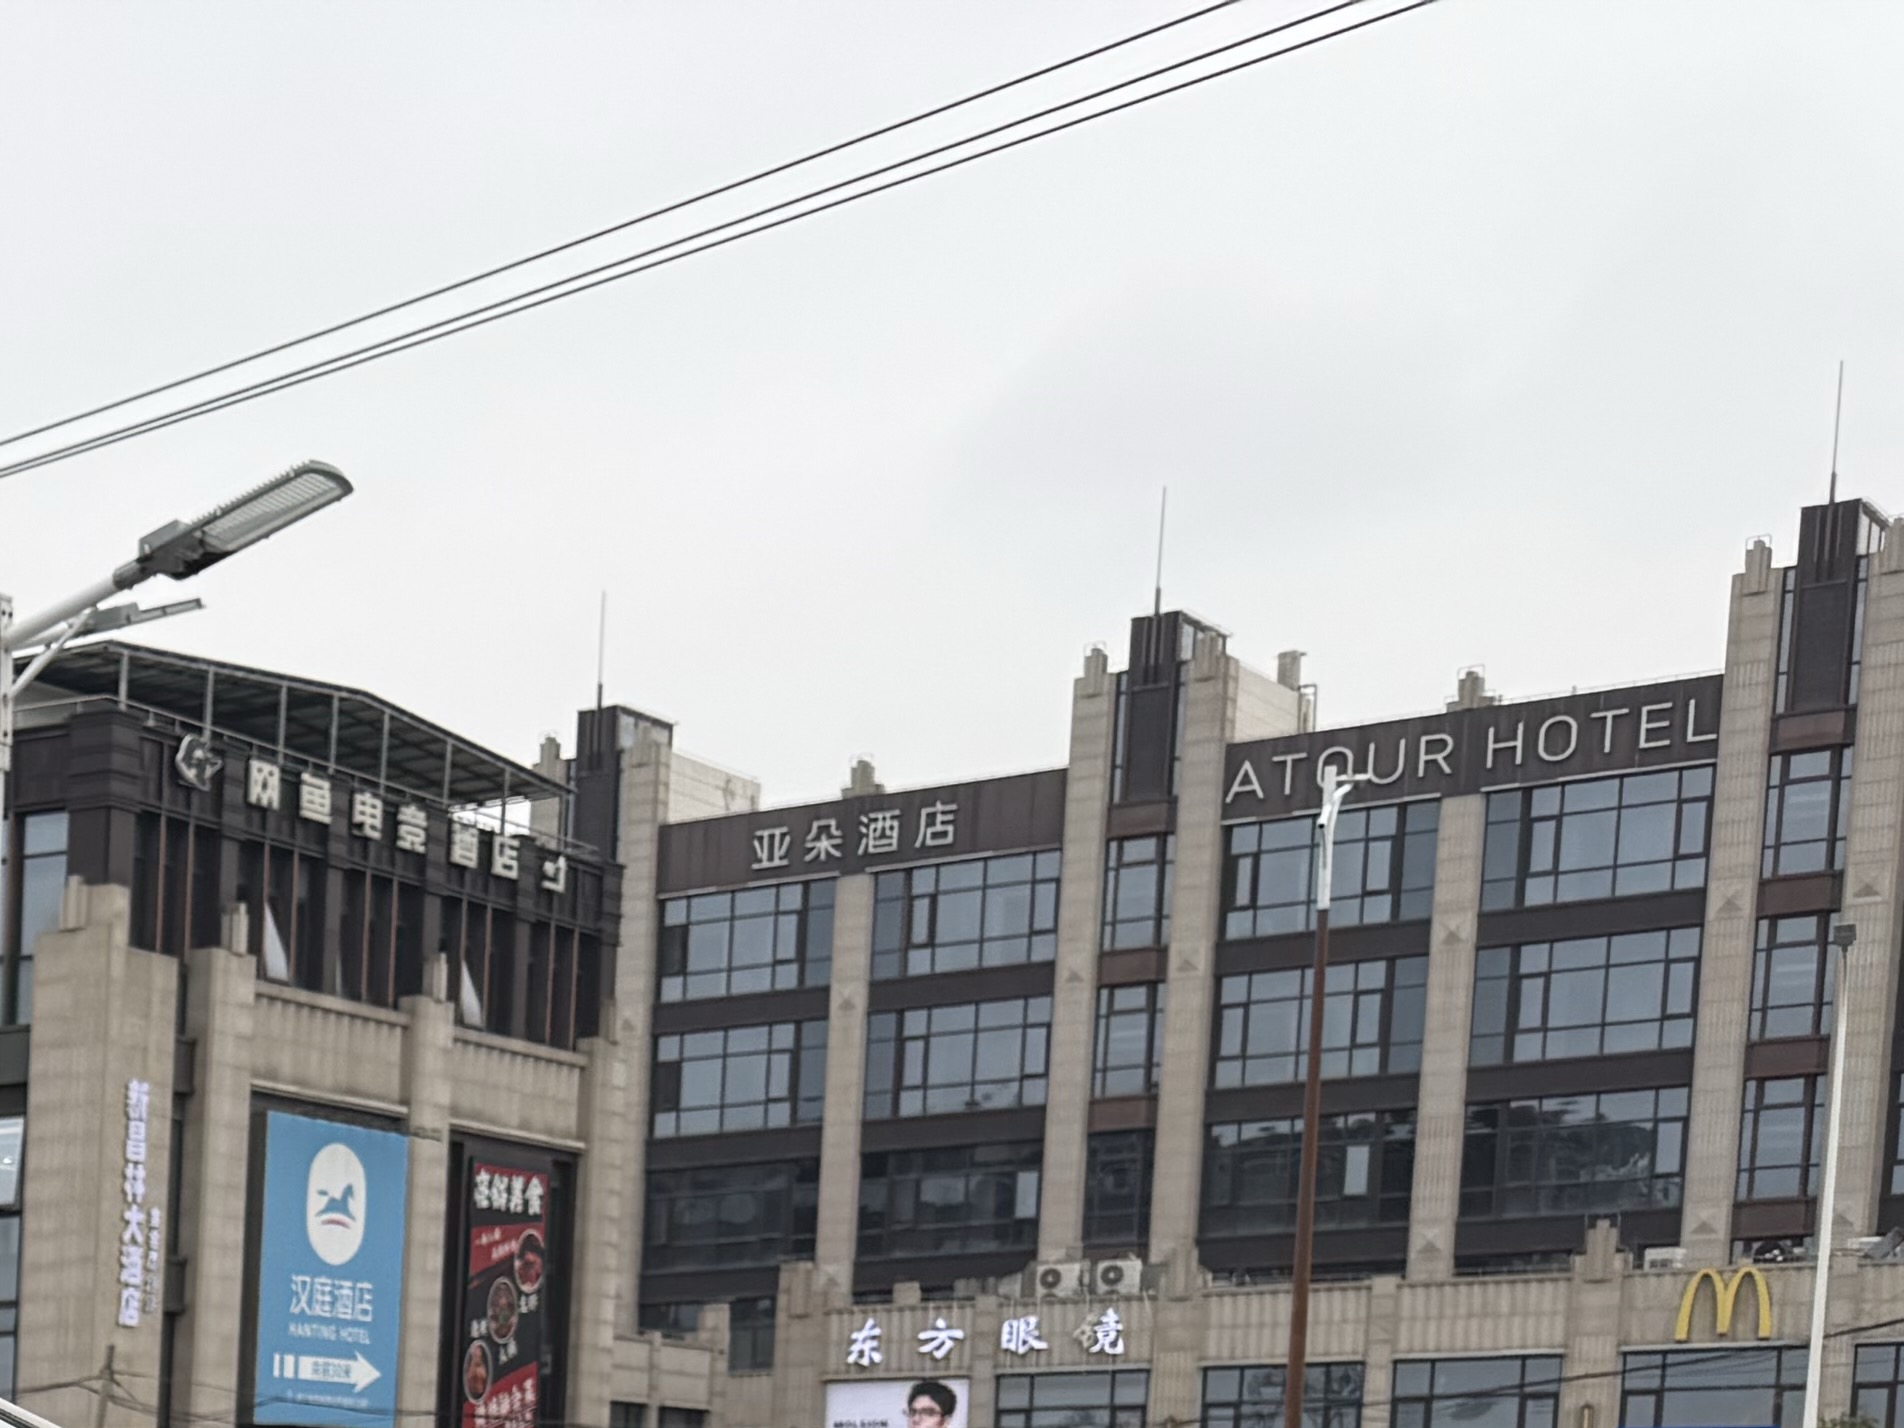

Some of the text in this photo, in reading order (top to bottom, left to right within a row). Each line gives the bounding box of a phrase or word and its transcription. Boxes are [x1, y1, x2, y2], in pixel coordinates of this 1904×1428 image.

[1225, 699, 1717, 804] ATOUR HOTEL
[247, 759, 521, 881] 网鱼电竞酒店
[751, 801, 959, 870] 亚朵酒店
[289, 1273, 374, 1322] 汉庭酒店
[288, 1322, 337, 1341] HANTING
[846, 1307, 1125, 1367] 东方眼镜
